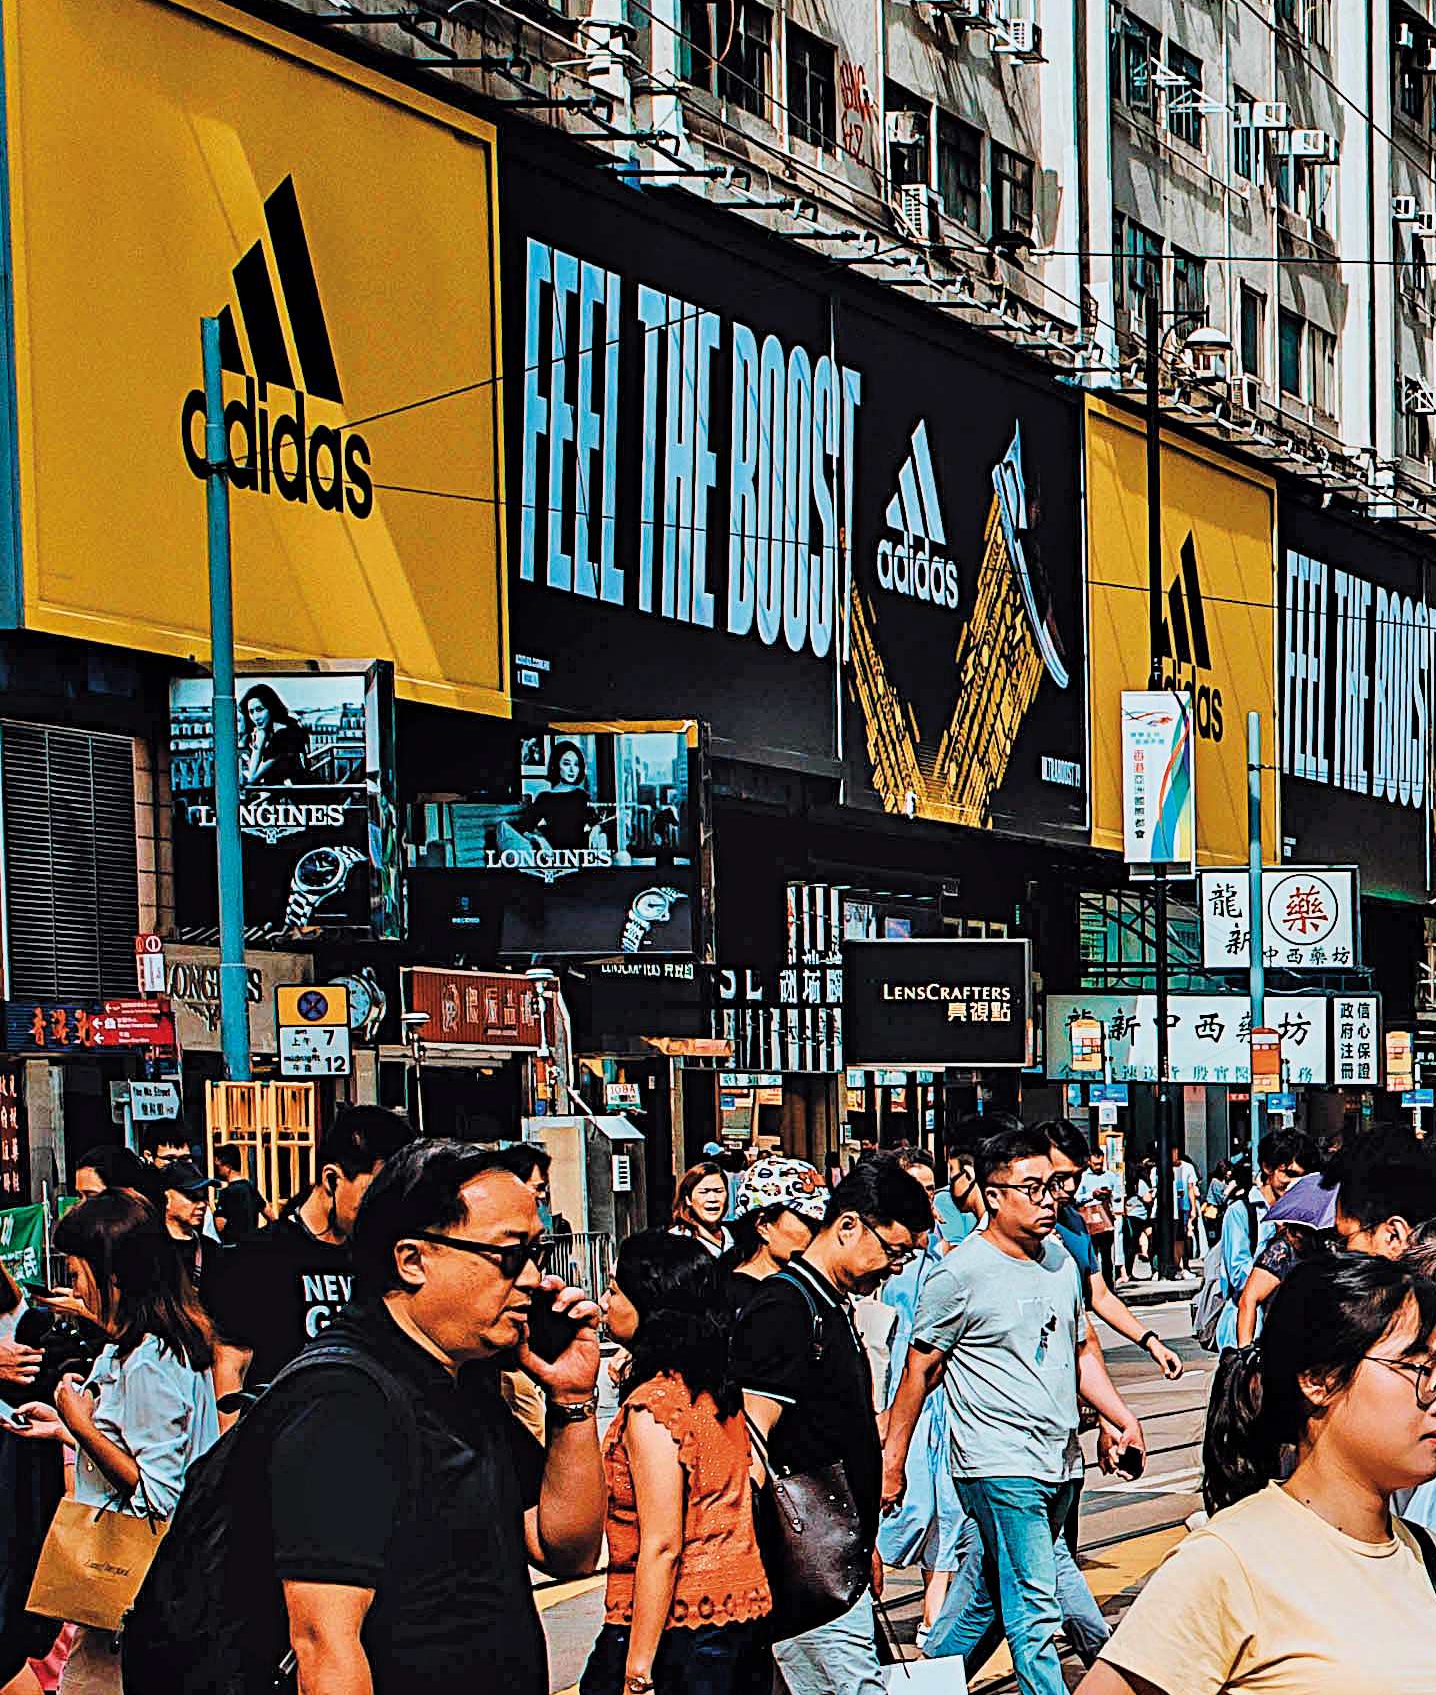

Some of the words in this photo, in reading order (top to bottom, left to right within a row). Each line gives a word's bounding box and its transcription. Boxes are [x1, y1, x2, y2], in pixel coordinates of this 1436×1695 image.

[181, 372, 373, 521] adidas
[520, 235, 625, 606] FEEL
[637, 283, 721, 628] THE
[727, 321, 862, 660] BOOST
[876, 531, 959, 610] adidas
[1283, 548, 1330, 789] FEEL
[1333, 568, 1373, 797] THE
[199, 803, 345, 828] LNGINES
[485, 848, 615, 869] LONGINES
[883, 983, 1011, 1001] LENSCRAFTERS
[947, 1002, 1011, 1022] 亮視點
[322, 1029, 335, 1046] 7
[1357, 1001, 1371, 1081] 信心保證
[324, 1055, 346, 1073] 12
